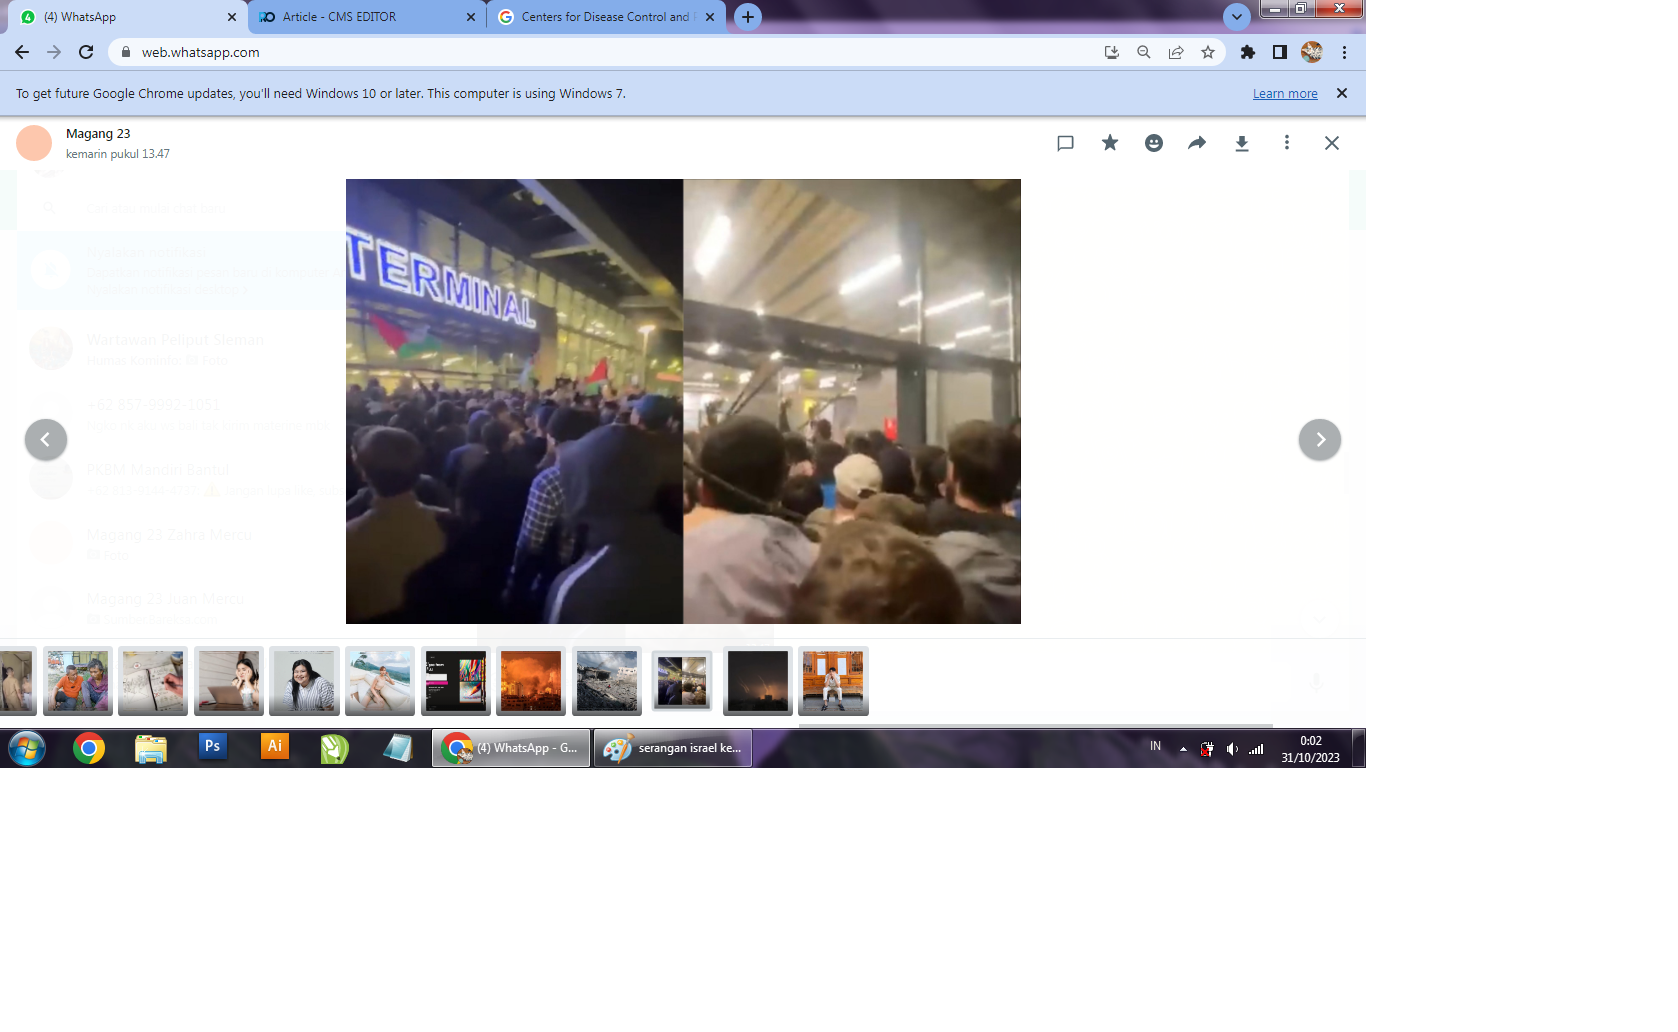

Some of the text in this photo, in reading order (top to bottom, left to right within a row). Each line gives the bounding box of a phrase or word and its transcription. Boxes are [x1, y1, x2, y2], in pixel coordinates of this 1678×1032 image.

[43, 11, 117, 25] (4) WhatsApp
[282, 11, 318, 22] Article
[327, 11, 353, 22] CMS
[356, 11, 397, 22] EDITOR
[521, 11, 563, 22] Centers
[564, 11, 582, 22] for
[583, 11, 625, 22] Disease
[626, 11, 667, 22] Control
[669, 11, 690, 22] and
[141, 46, 260, 61] web.whatsapp.com
[15, 87, 626, 102] To get future Google Chrome updates, you'll need Windows 10 or later. This computer is using Windows 7.
[1253, 88, 1319, 99] Learn more
[66, 128, 131, 142] Magang 23
[65, 148, 171, 162] kemarin pukul 13.47
[86, 202, 226, 214] Cari atau mulai chat baru
[87, 246, 206, 261] Nyalakan notifikasi
[87, 266, 140, 281] Dapatkan
[143, 266, 193, 278] notifikasi
[196, 269, 229, 281] pesan
[233, 266, 258, 278] baru
[261, 266, 272, 278] di
[275, 266, 330, 281] komputer
[346, 225, 537, 329] TERMINAL
[87, 283, 239, 298] Nyalakan notifikasi desktop
[86, 333, 264, 349] Wartawan Peliput Sleman
[86, 354, 229, 366] Humas Kominfo: Foto
[87, 398, 113, 411] +62
[86, 419, 331, 434] Ngko nk aku ws bali tak kirim materine mbk
[87, 463, 229, 476] PKBM Mandiri Bantul
[87, 485, 109, 496] +62
[223, 485, 264, 499] Jangan
[266, 484, 291, 499] lupa
[294, 484, 316, 498] like,
[87, 528, 252, 544] Magang 23 Zahra Mercu
[103, 550, 130, 561] Foto
[87, 592, 244, 608] Magang 23 Juan Mercu
[205, 739, 220, 751] Ps
[267, 739, 282, 752] Ai
[1150, 740, 1161, 751] IN
[1300, 735, 1323, 746] 0:02
[477, 742, 491, 755] (4)
[493, 742, 549, 756] WhatsApp
[560, 742, 577, 753] G...
[638, 742, 741, 755] serangan israel ke...
[1281, 752, 1340, 764] 31/10/2023
